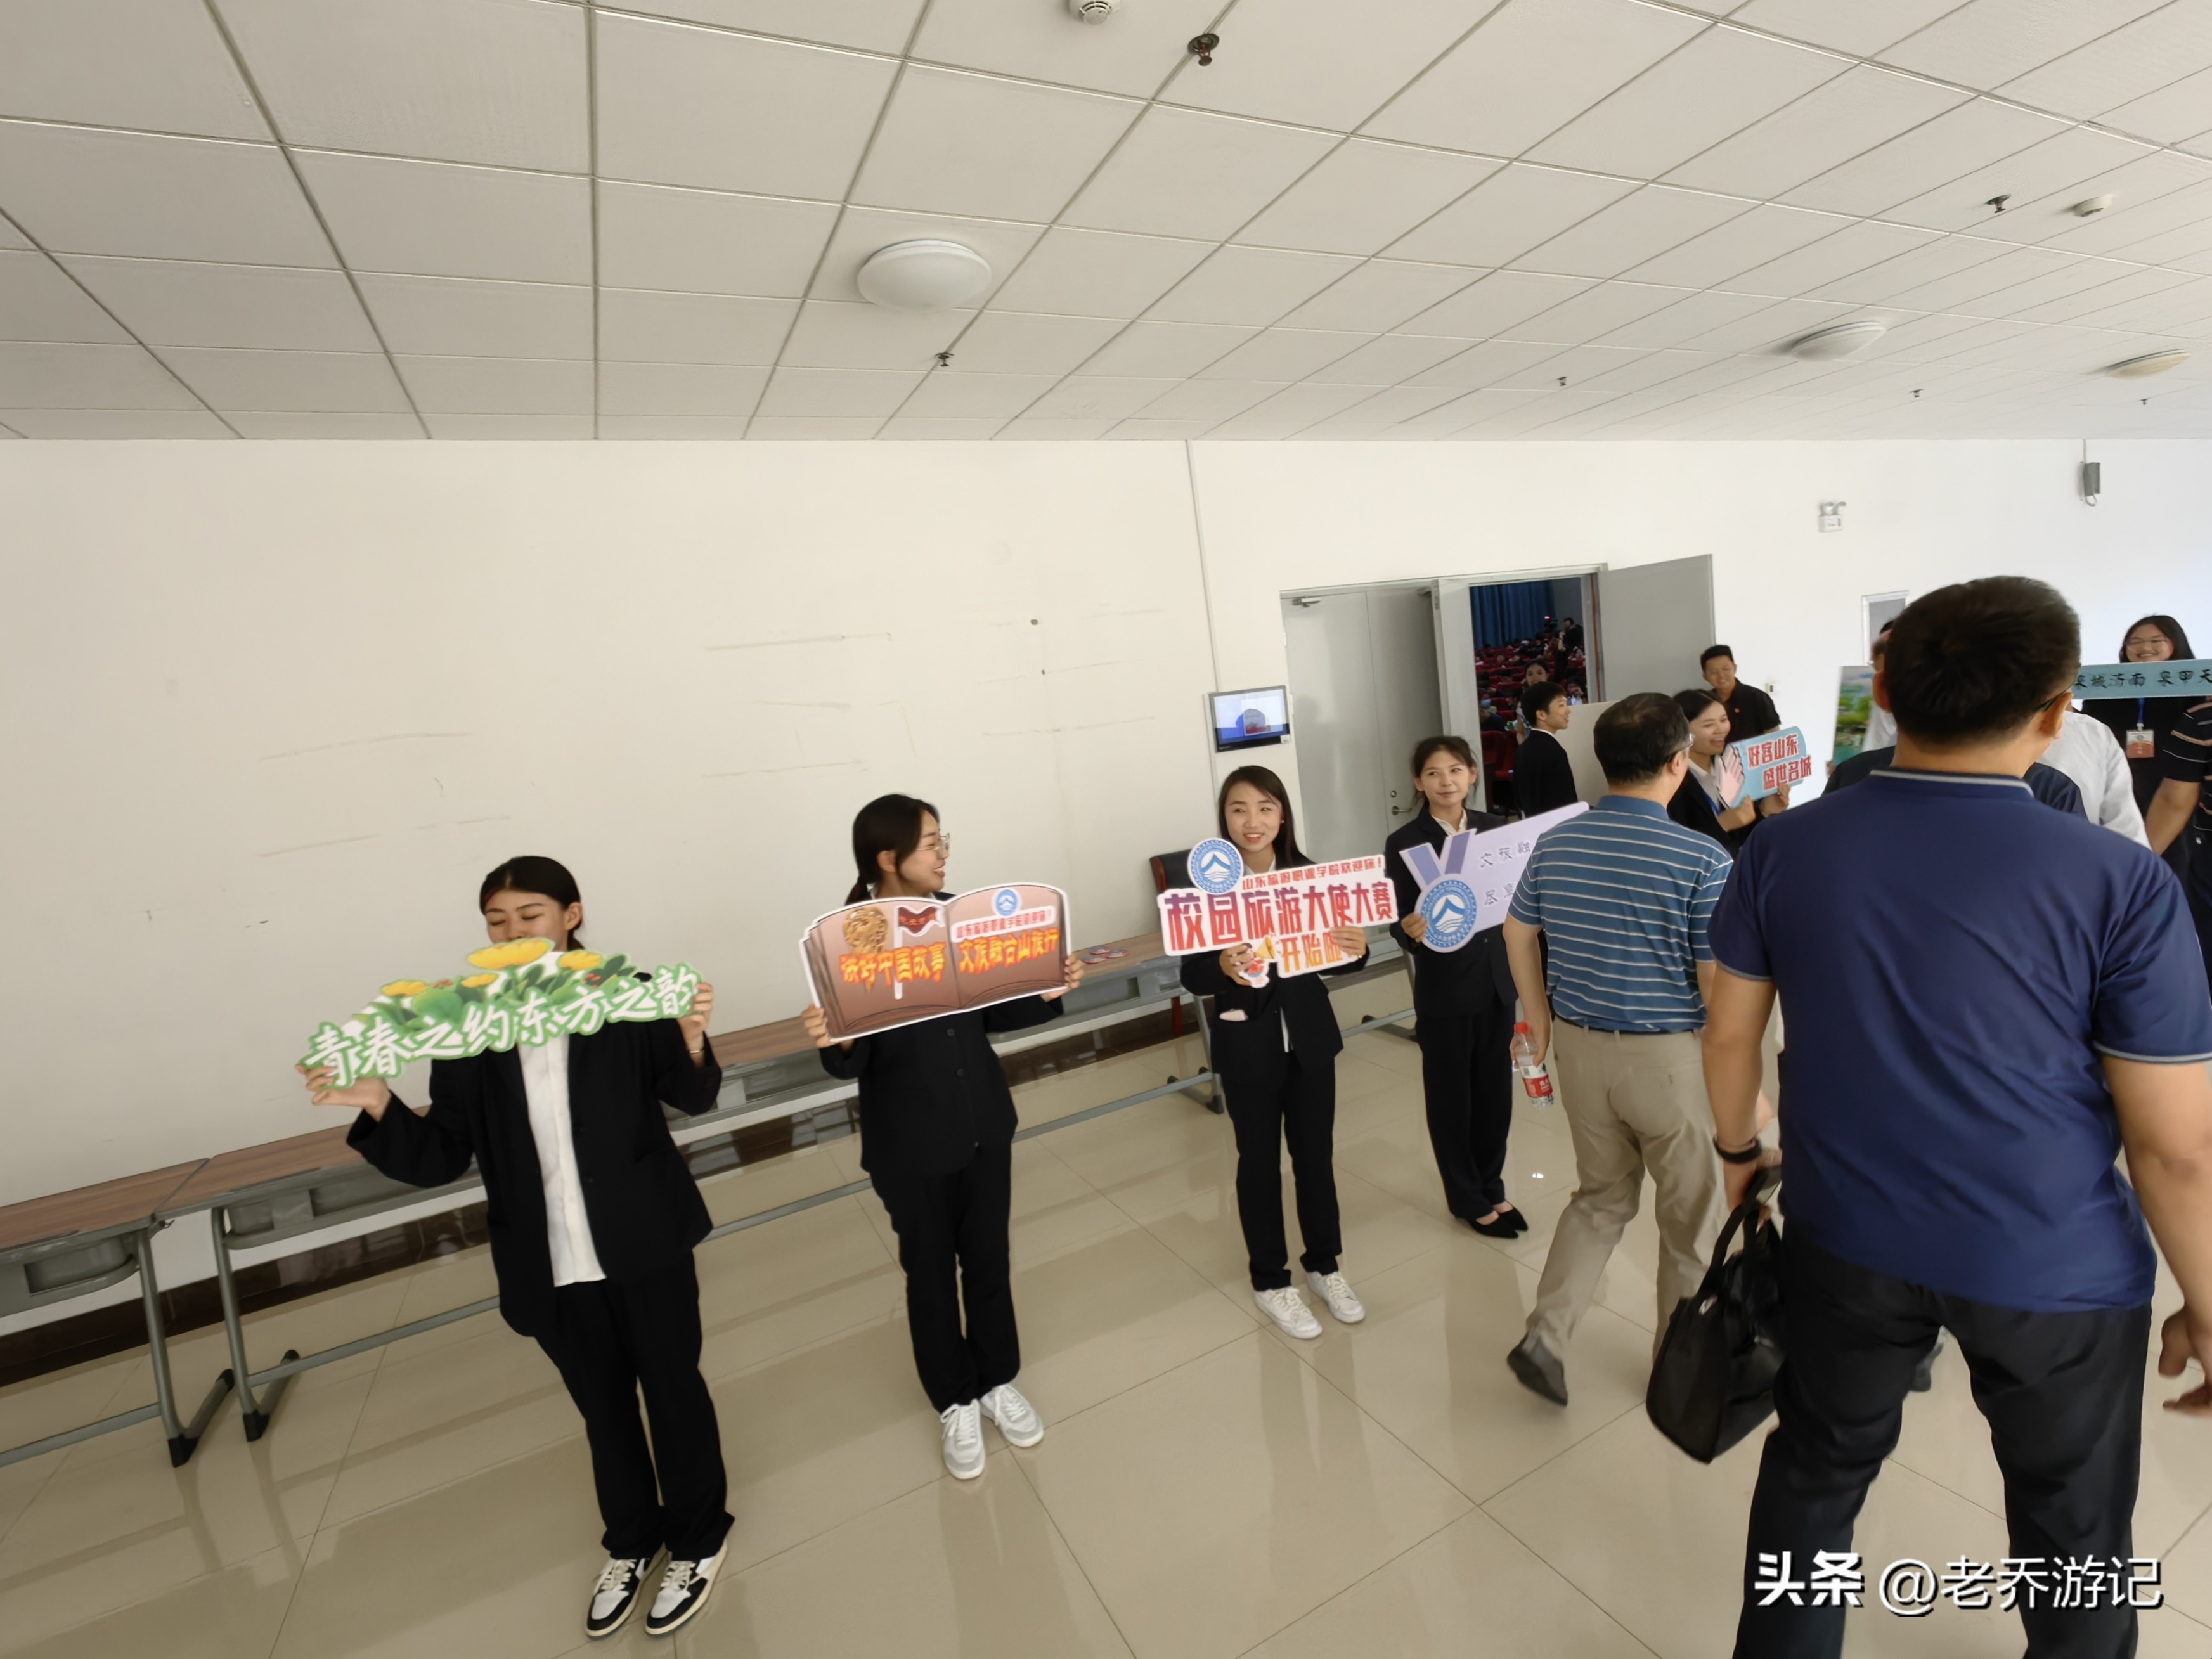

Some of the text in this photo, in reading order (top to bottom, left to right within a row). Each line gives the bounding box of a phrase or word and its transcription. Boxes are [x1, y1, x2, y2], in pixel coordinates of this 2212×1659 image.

[1748, 733, 1799, 768] 好客山东
[1763, 755, 1812, 791] 盛世名城
[1164, 881, 1394, 951] 校园旅游大使大赛
[306, 965, 699, 1087] 青春之约东方之韵
